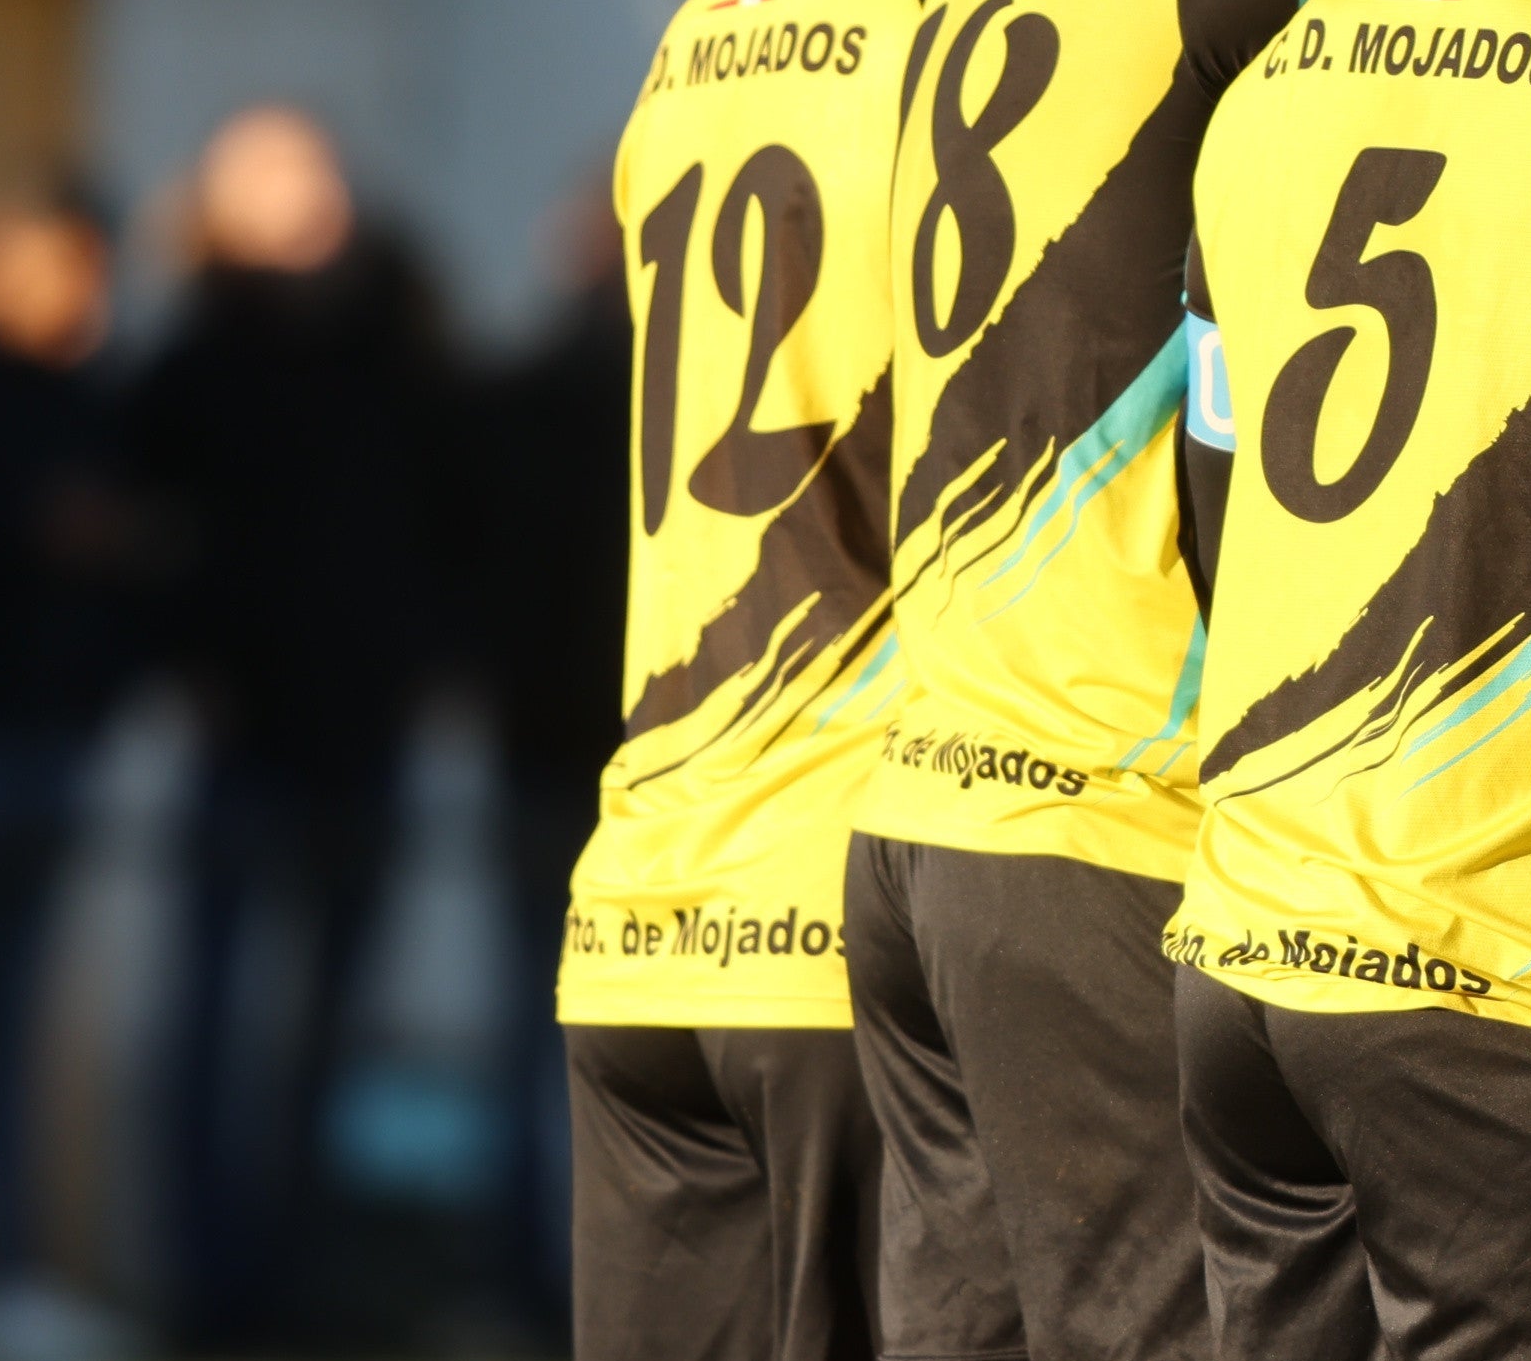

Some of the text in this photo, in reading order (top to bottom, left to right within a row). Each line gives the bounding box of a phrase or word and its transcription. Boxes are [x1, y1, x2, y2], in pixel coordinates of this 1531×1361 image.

[686, 21, 868, 87] MOJADOS
[1297, 18, 1334, 71] D.
[640, 143, 838, 538] 12
[1260, 146, 1448, 524] 5
[622, 908, 664, 956] de
